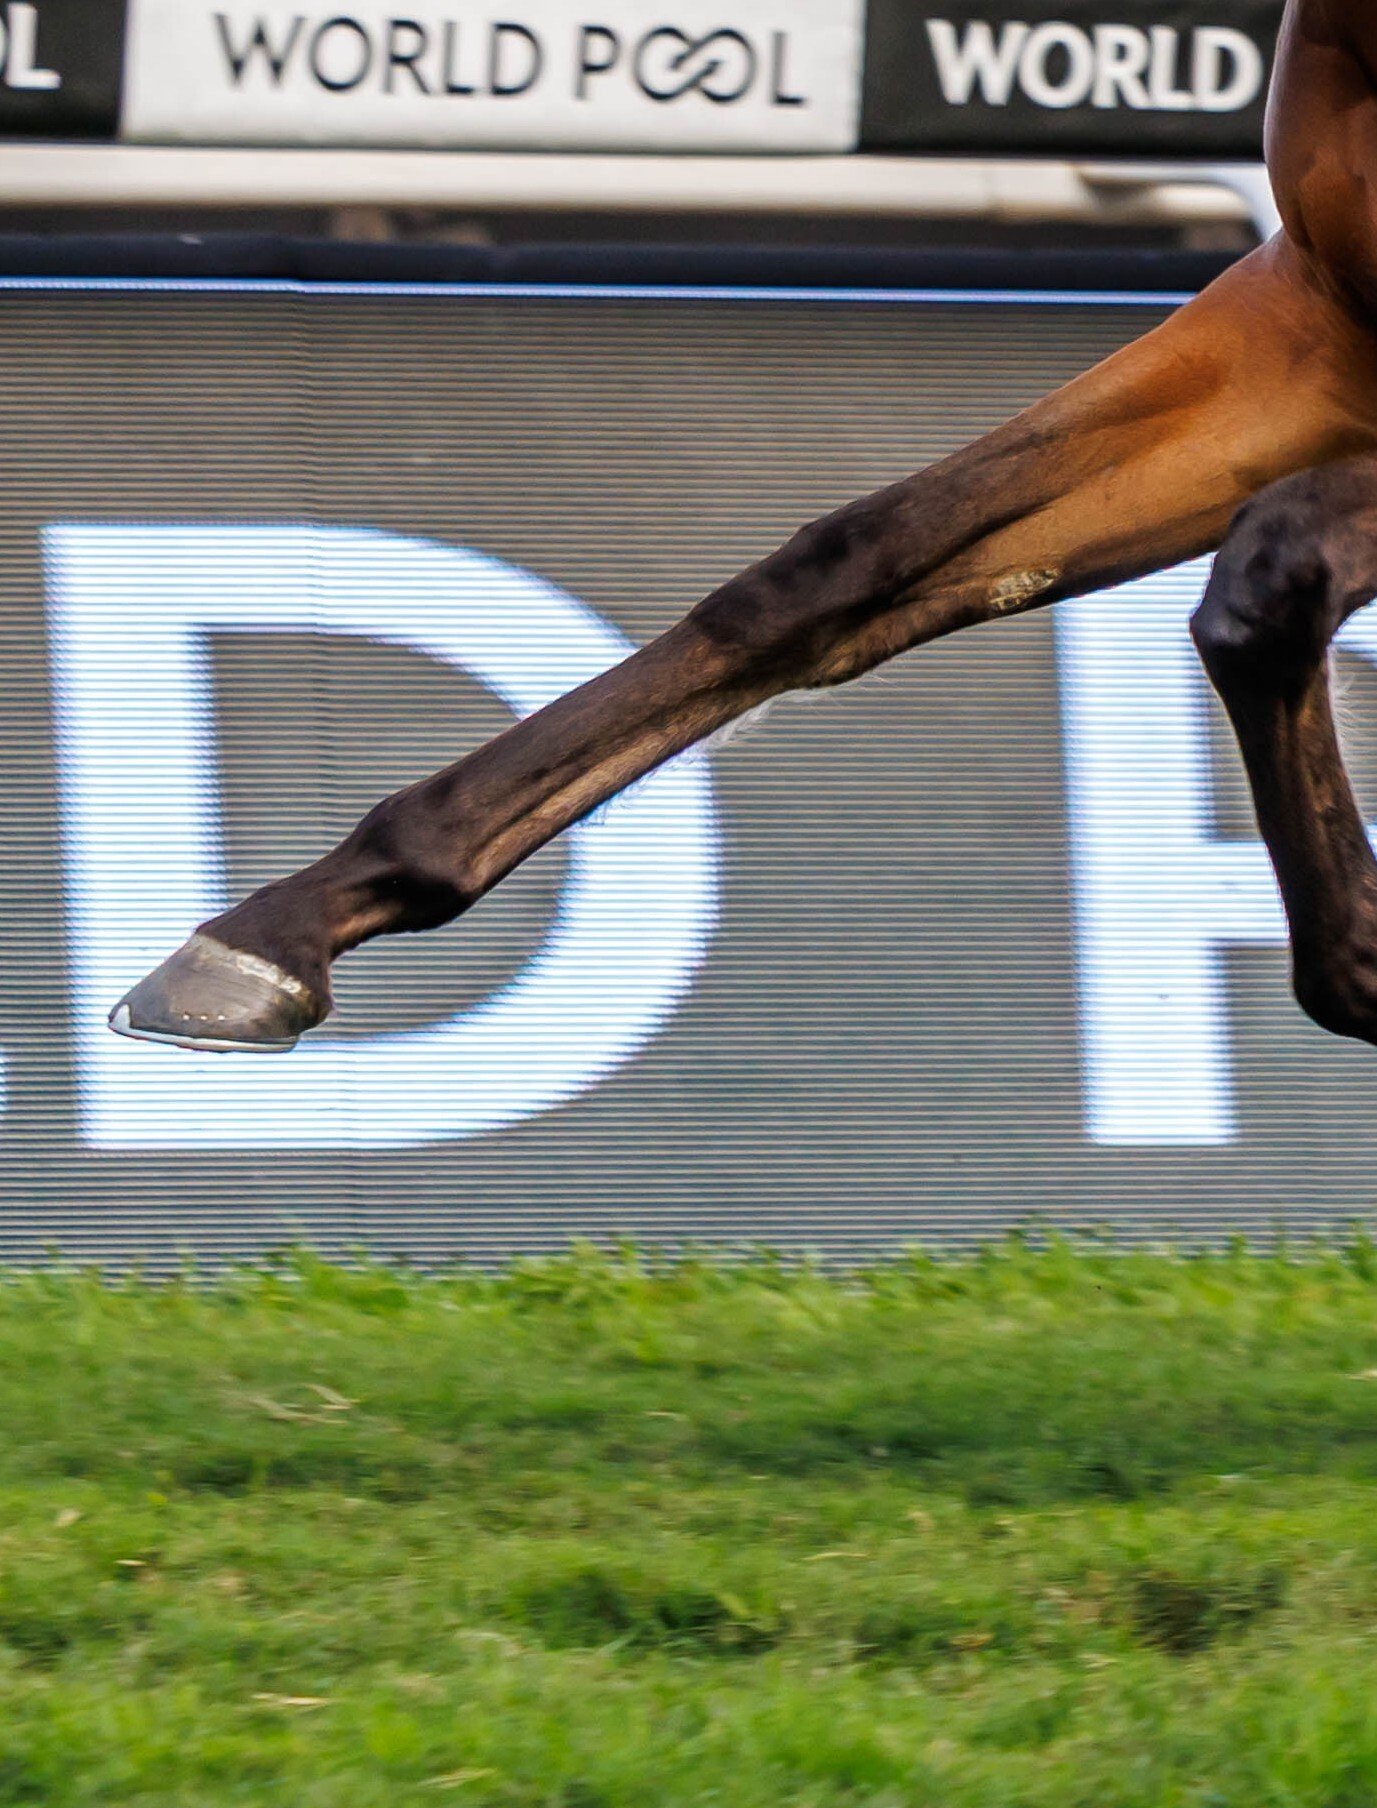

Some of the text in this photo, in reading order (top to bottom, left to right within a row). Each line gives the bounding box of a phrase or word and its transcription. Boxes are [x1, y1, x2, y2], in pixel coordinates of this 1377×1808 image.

[0, 1, 61, 89] L
[212, 12, 808, 108] WORLD POOL
[925, 18, 1264, 113] WORLD
[0, 521, 722, 1152] D
